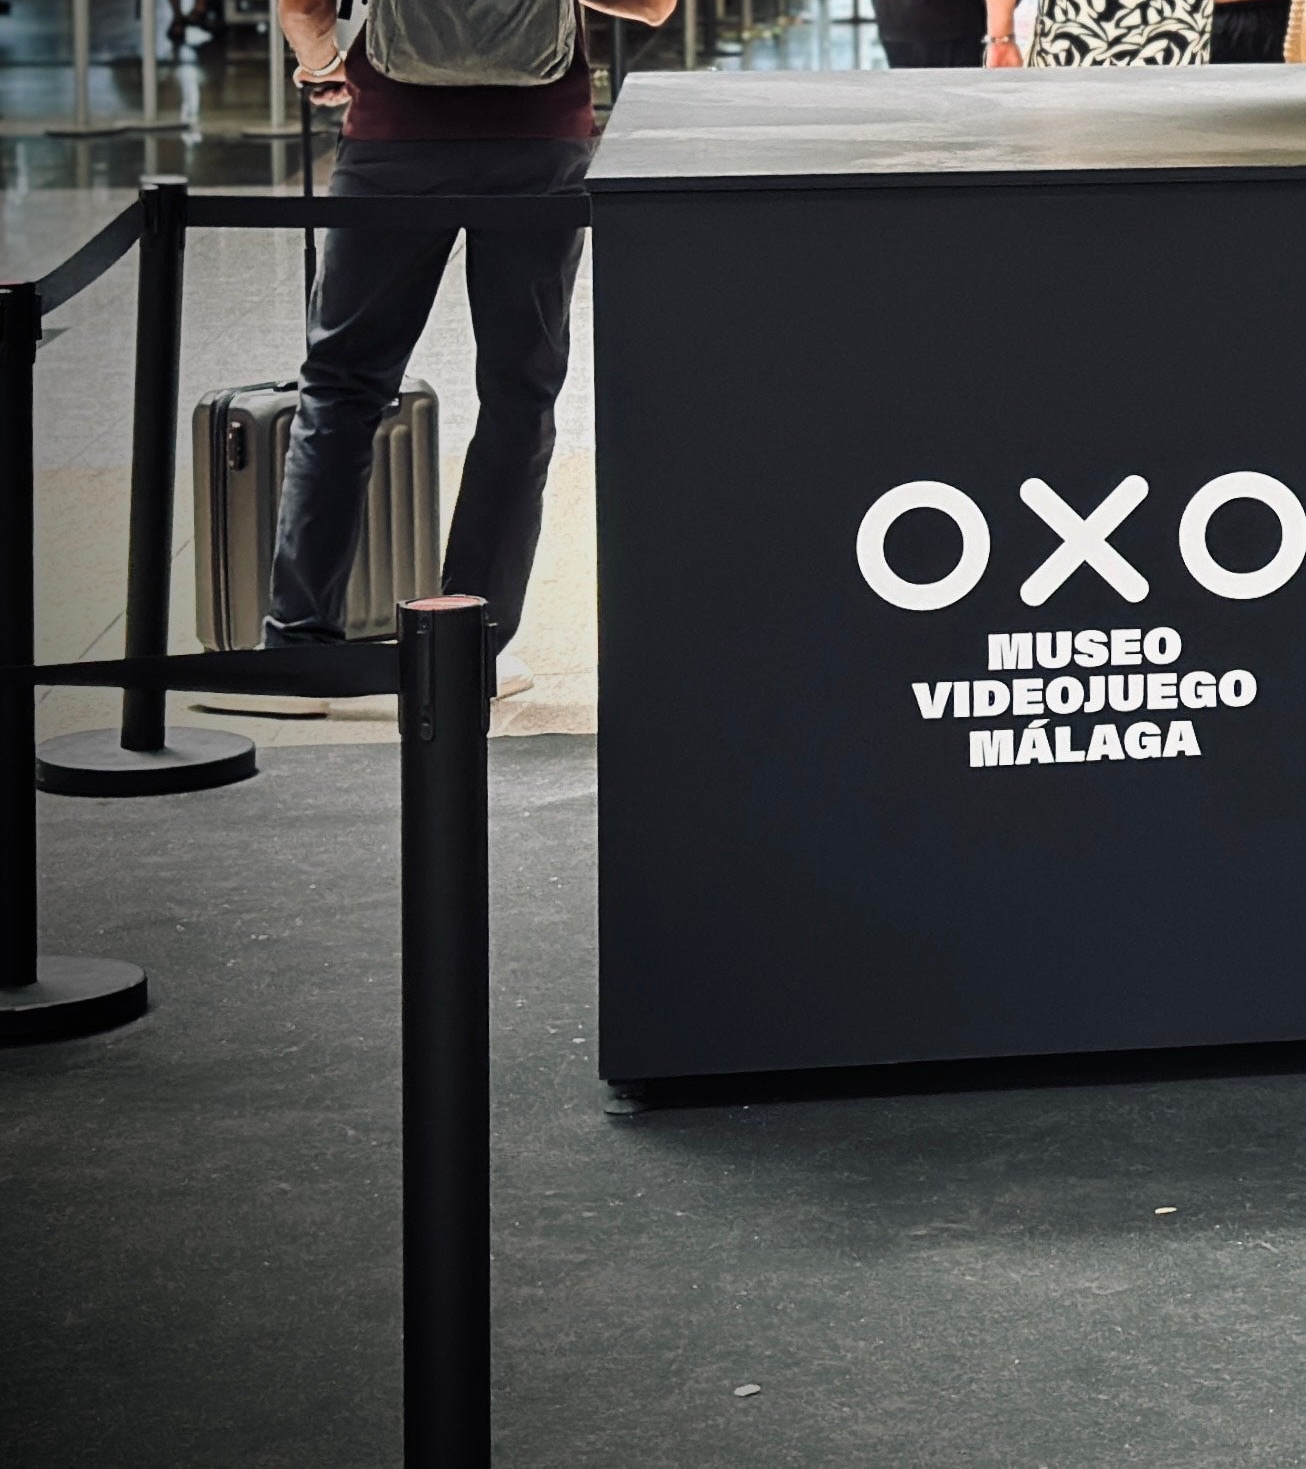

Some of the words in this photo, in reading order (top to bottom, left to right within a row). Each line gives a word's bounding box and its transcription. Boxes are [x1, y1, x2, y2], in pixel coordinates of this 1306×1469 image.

[987, 626, 1182, 671] MUSEO
[911, 669, 1258, 720] VIDEOJUEGO
[968, 718, 1202, 768] MÁLAGA
